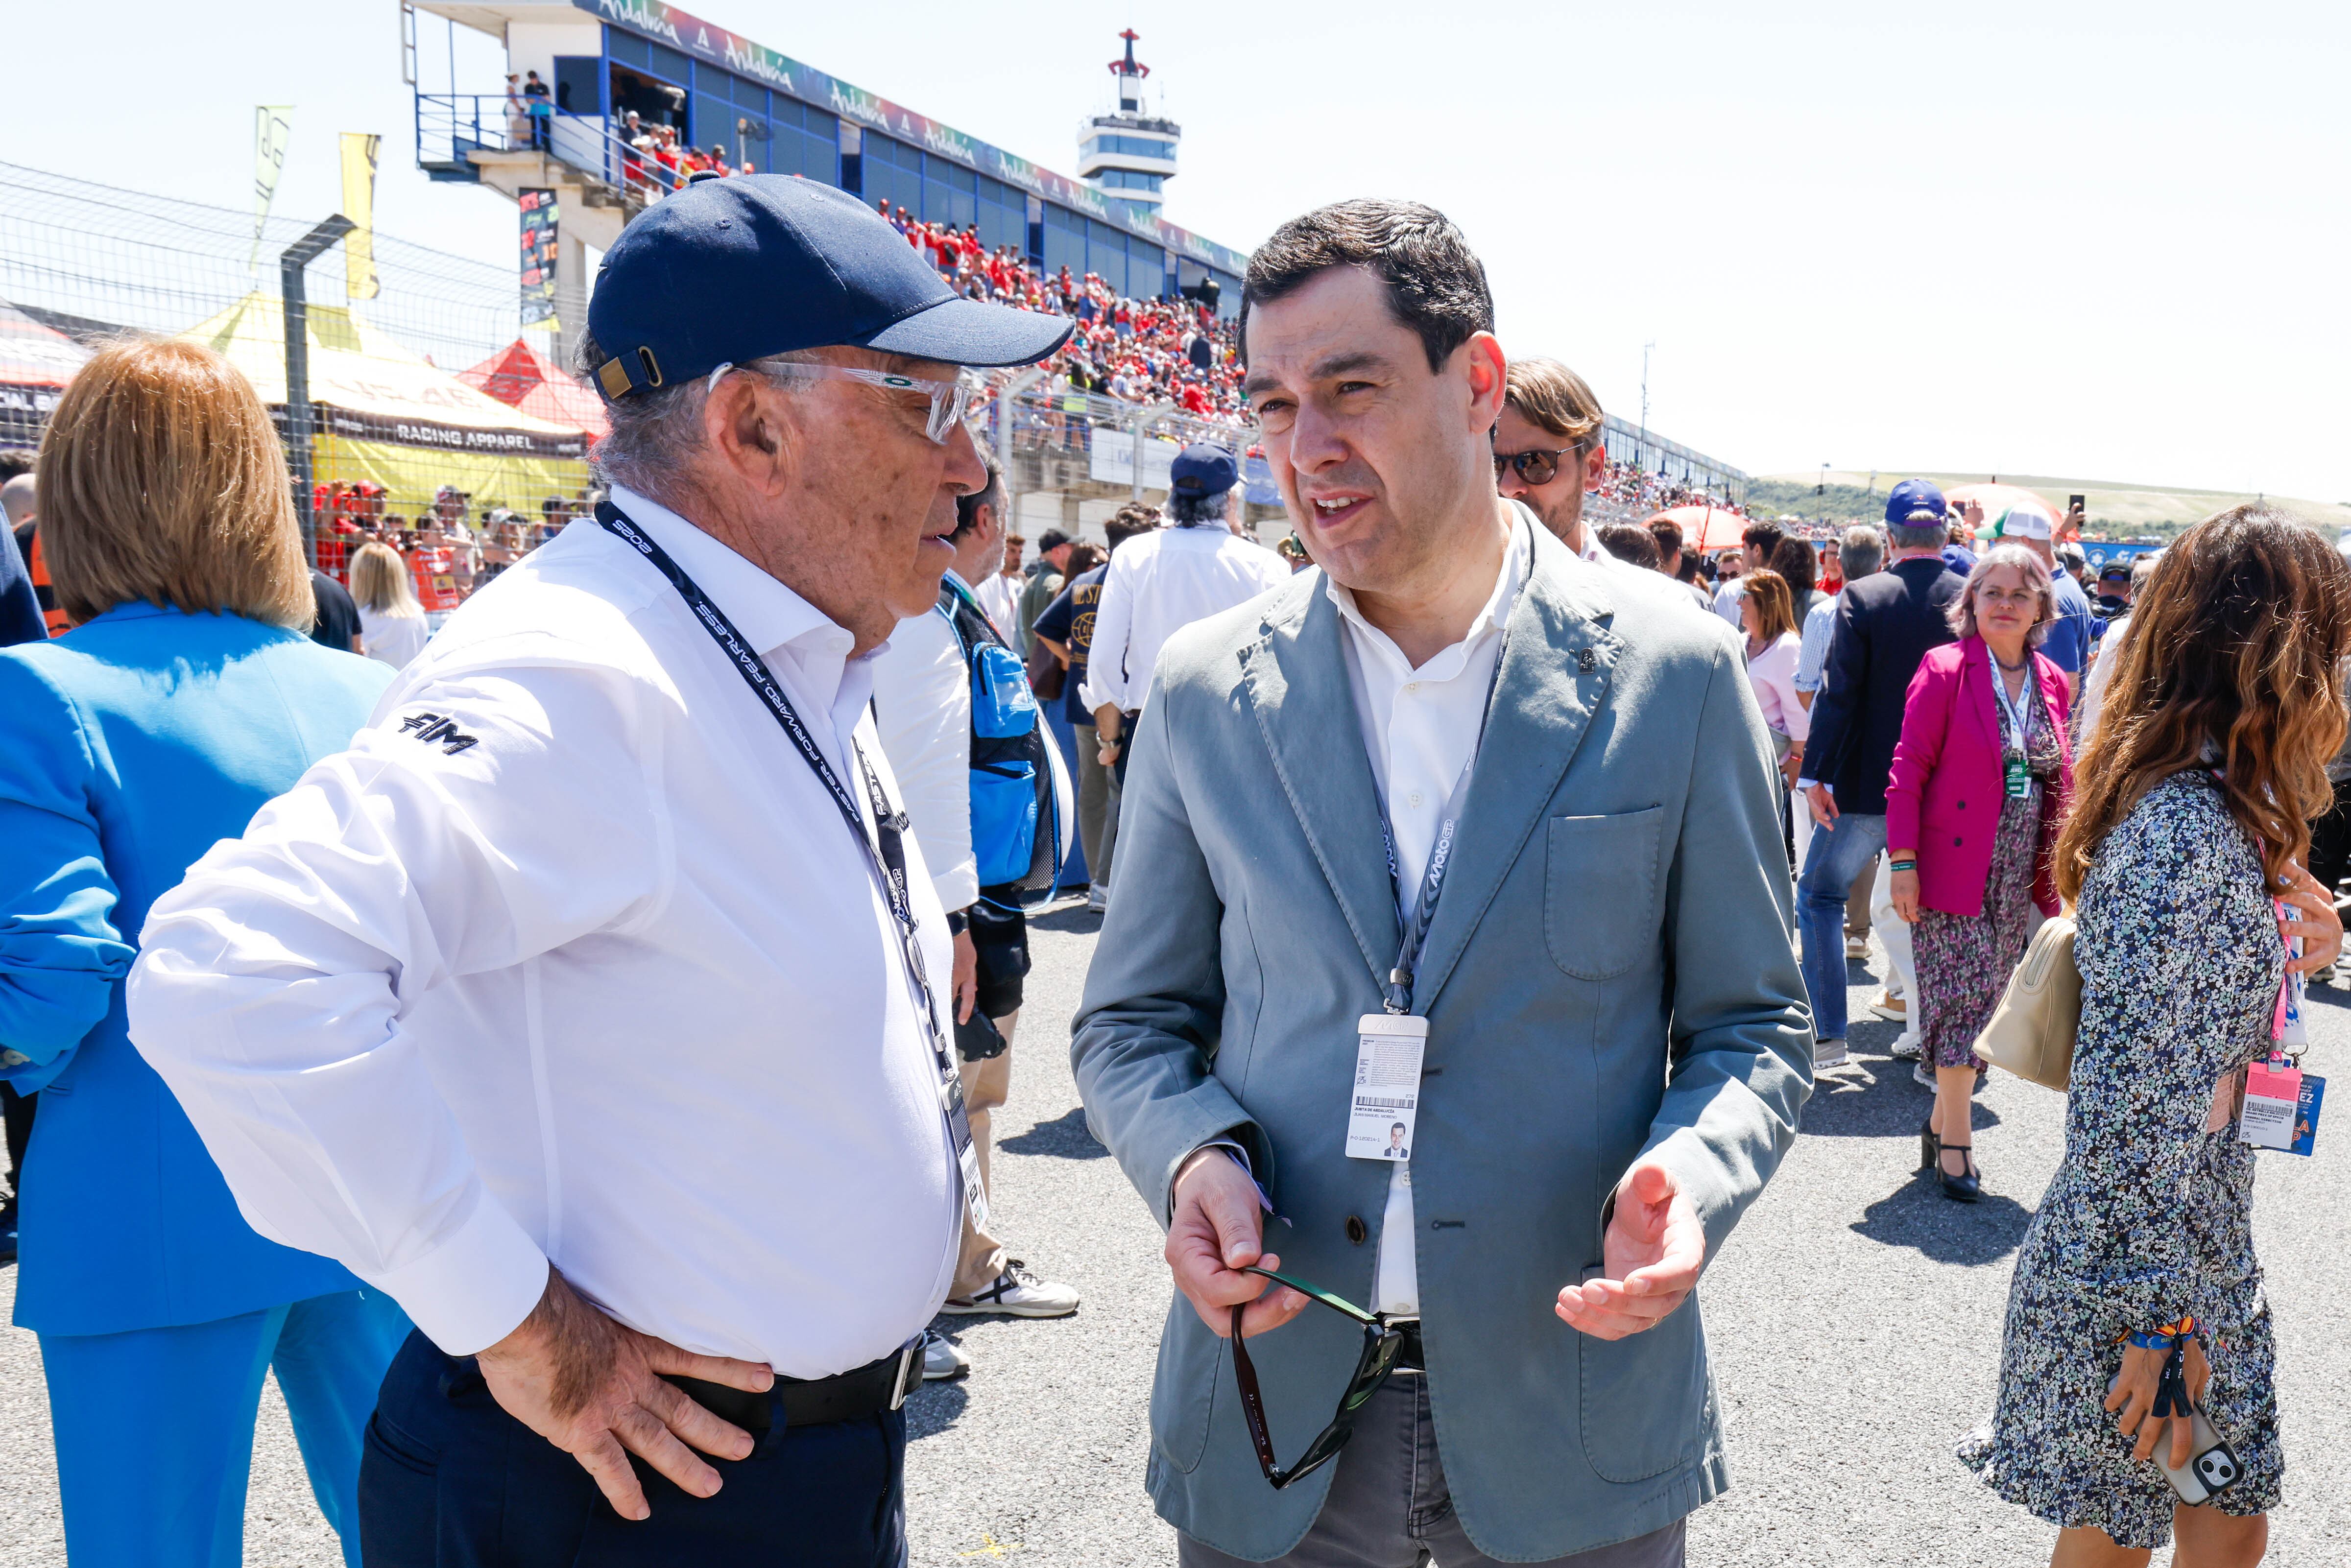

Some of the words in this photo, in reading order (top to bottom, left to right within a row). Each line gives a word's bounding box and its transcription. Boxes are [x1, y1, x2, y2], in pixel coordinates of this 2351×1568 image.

[724, 33, 794, 92] Andalucía
[397, 423, 462, 446] RACING
[466, 431, 534, 450] APPAREL
[612, 519, 652, 554] 2025
[696, 601, 766, 683] FEARLESS.
[765, 683, 819, 761] FORWARD.
[819, 760, 860, 823] FASTER.
[398, 711, 479, 755] FIM
[1429, 819, 1455, 888] MotoGP
[2299, 1092, 2314, 1104] EZ
